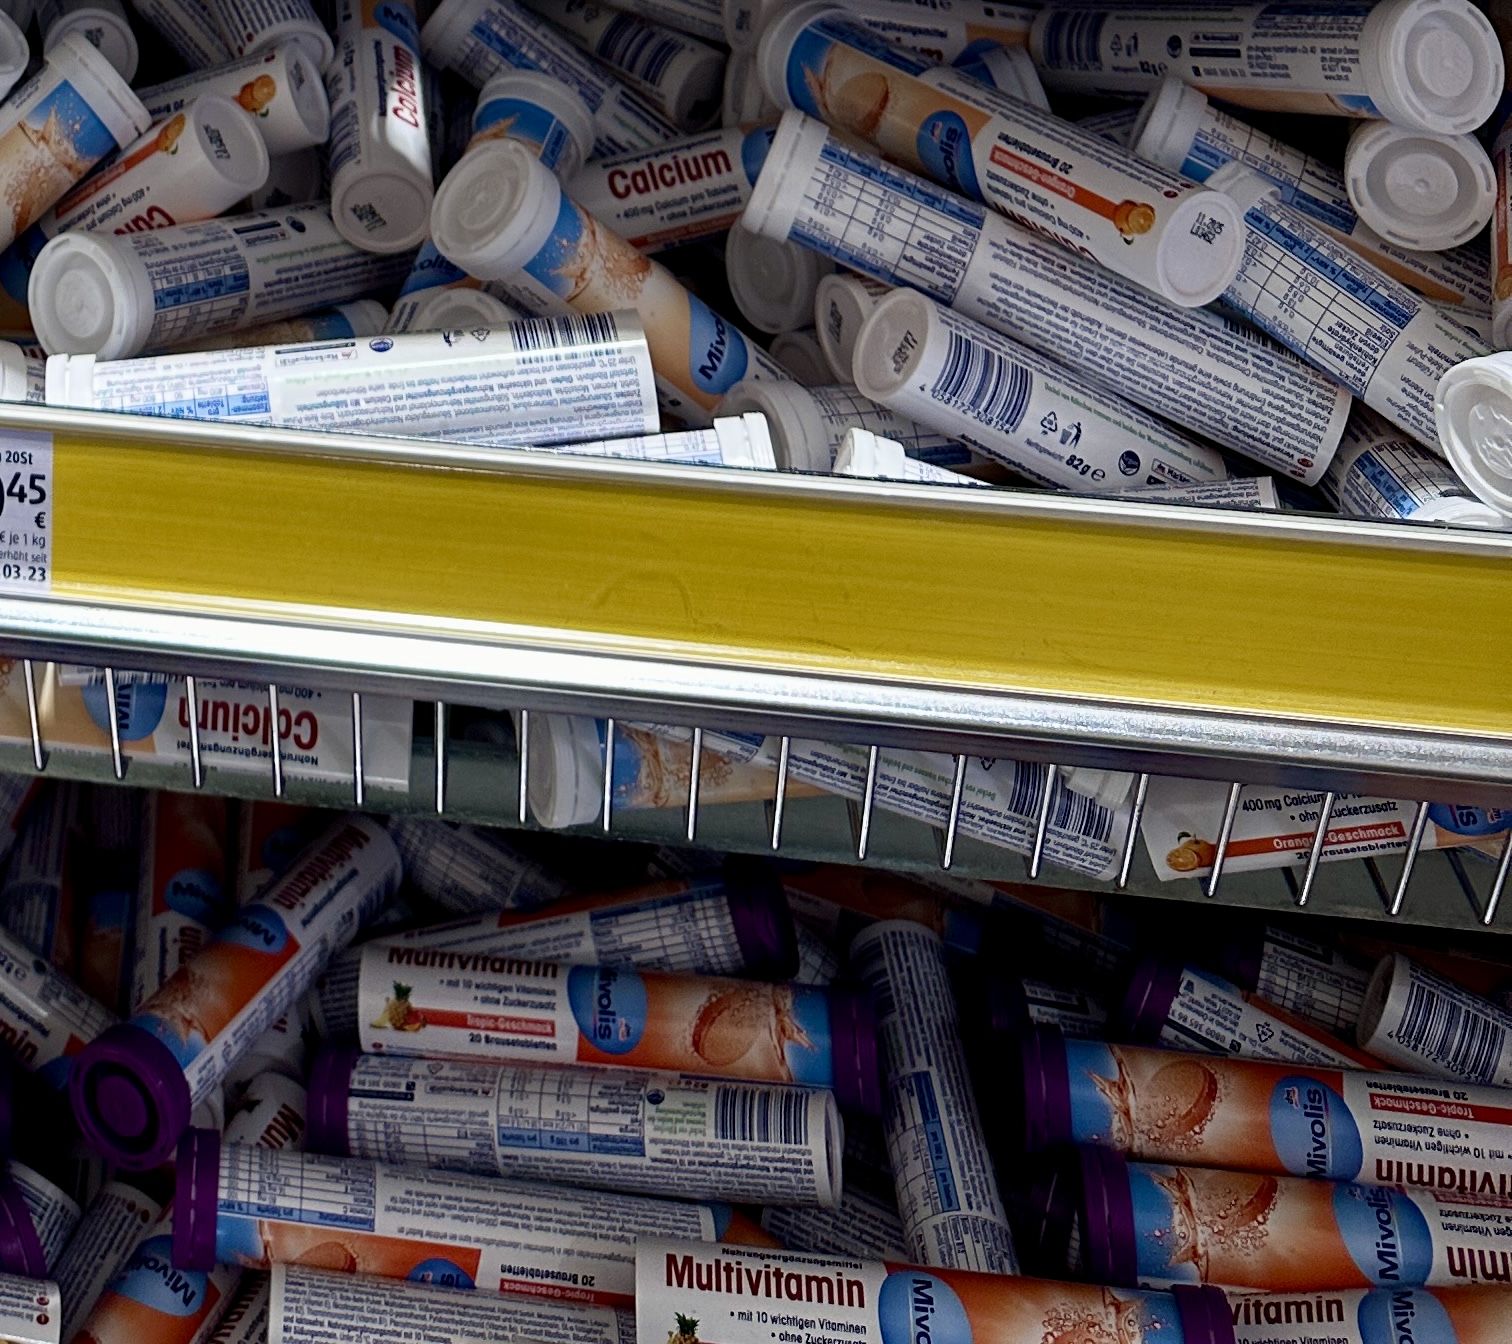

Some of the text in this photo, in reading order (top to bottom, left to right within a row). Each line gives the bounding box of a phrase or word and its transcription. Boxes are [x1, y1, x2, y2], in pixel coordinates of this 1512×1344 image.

[392, 44, 420, 129] Calcium
[607, 148, 733, 201] Calcium
[5, 450, 33, 465] 20St
[0, 530, 6, 543] €
[9, 530, 20, 546] je
[23, 533, 28, 545] 1
[32, 534, 46, 549] kg
[34, 512, 47, 529] €
[31, 552, 47, 564] seit
[388, 946, 557, 979] Multivitamin
[1374, 1097, 1475, 1120] Tropic-Geschmack
[1305, 1088, 1328, 1178] Mivolis
[1366, 1185, 1400, 1281] Mivolis
[665, 1252, 866, 1309] Multivitamin
[737, 1310, 867, 1336] mit 10 wichtigen Vitaminen
[912, 1278, 935, 1344] Mivo
[1390, 1289, 1415, 1344] Mivo
